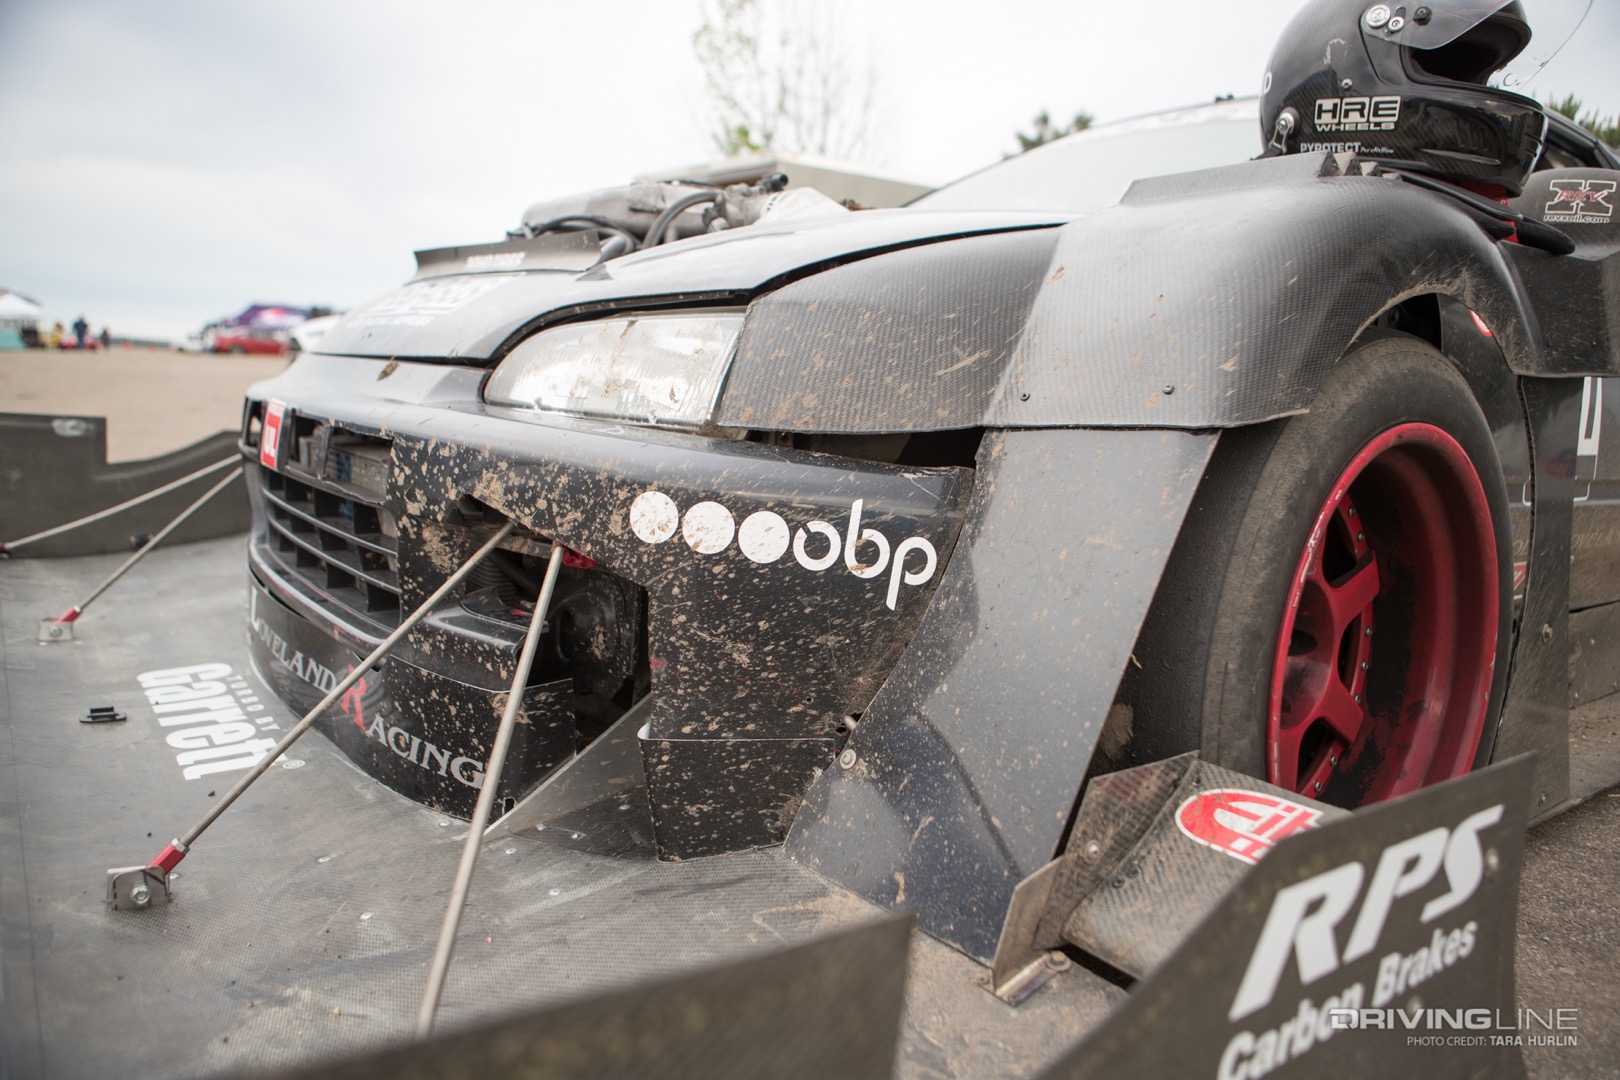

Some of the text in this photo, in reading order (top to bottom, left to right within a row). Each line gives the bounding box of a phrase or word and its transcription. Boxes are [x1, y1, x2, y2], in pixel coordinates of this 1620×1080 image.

[1300, 142, 1361, 153] PYROTECT
[1315, 97, 1399, 122] HRE
[1316, 123, 1395, 132] WHEELS
[793, 498, 937, 611] obp
[136, 662, 287, 781] Garrett
[226, 674, 281, 732] TURBO BY
[1228, 803, 1504, 1023] RPS
[1216, 921, 1478, 1080] Carbon Brakes
